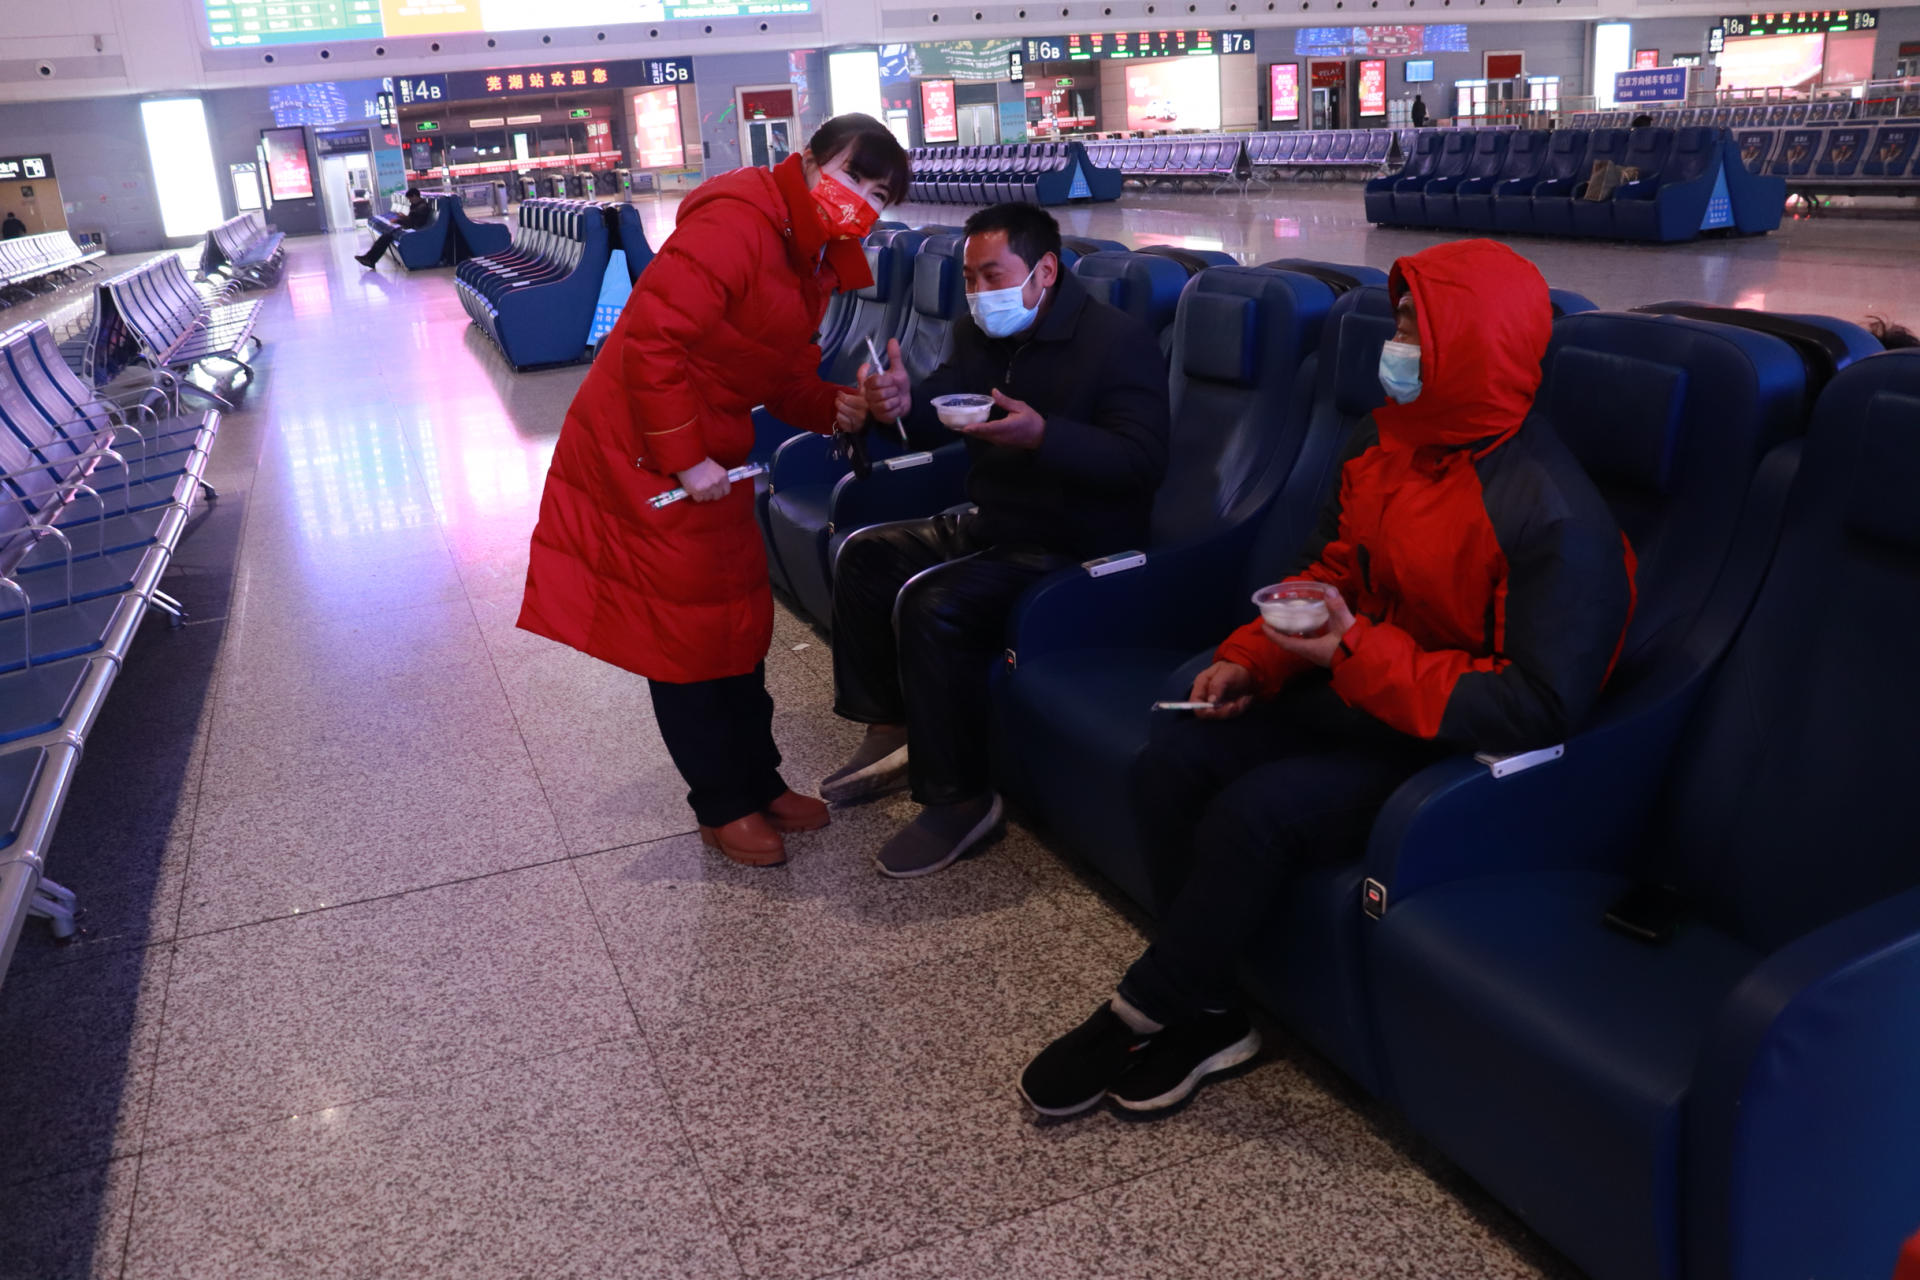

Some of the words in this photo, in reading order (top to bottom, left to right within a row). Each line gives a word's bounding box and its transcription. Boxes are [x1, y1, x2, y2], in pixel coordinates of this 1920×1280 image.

[1730, 18, 1744, 34] 8B
[1862, 12, 1875, 28] 9B
[1040, 41, 1060, 59] 6B
[1233, 34, 1250, 51] 7B
[486, 68, 608, 91] 芜湖站欢迎您
[665, 62, 689, 81] 5B
[415, 80, 441, 99] 4B
